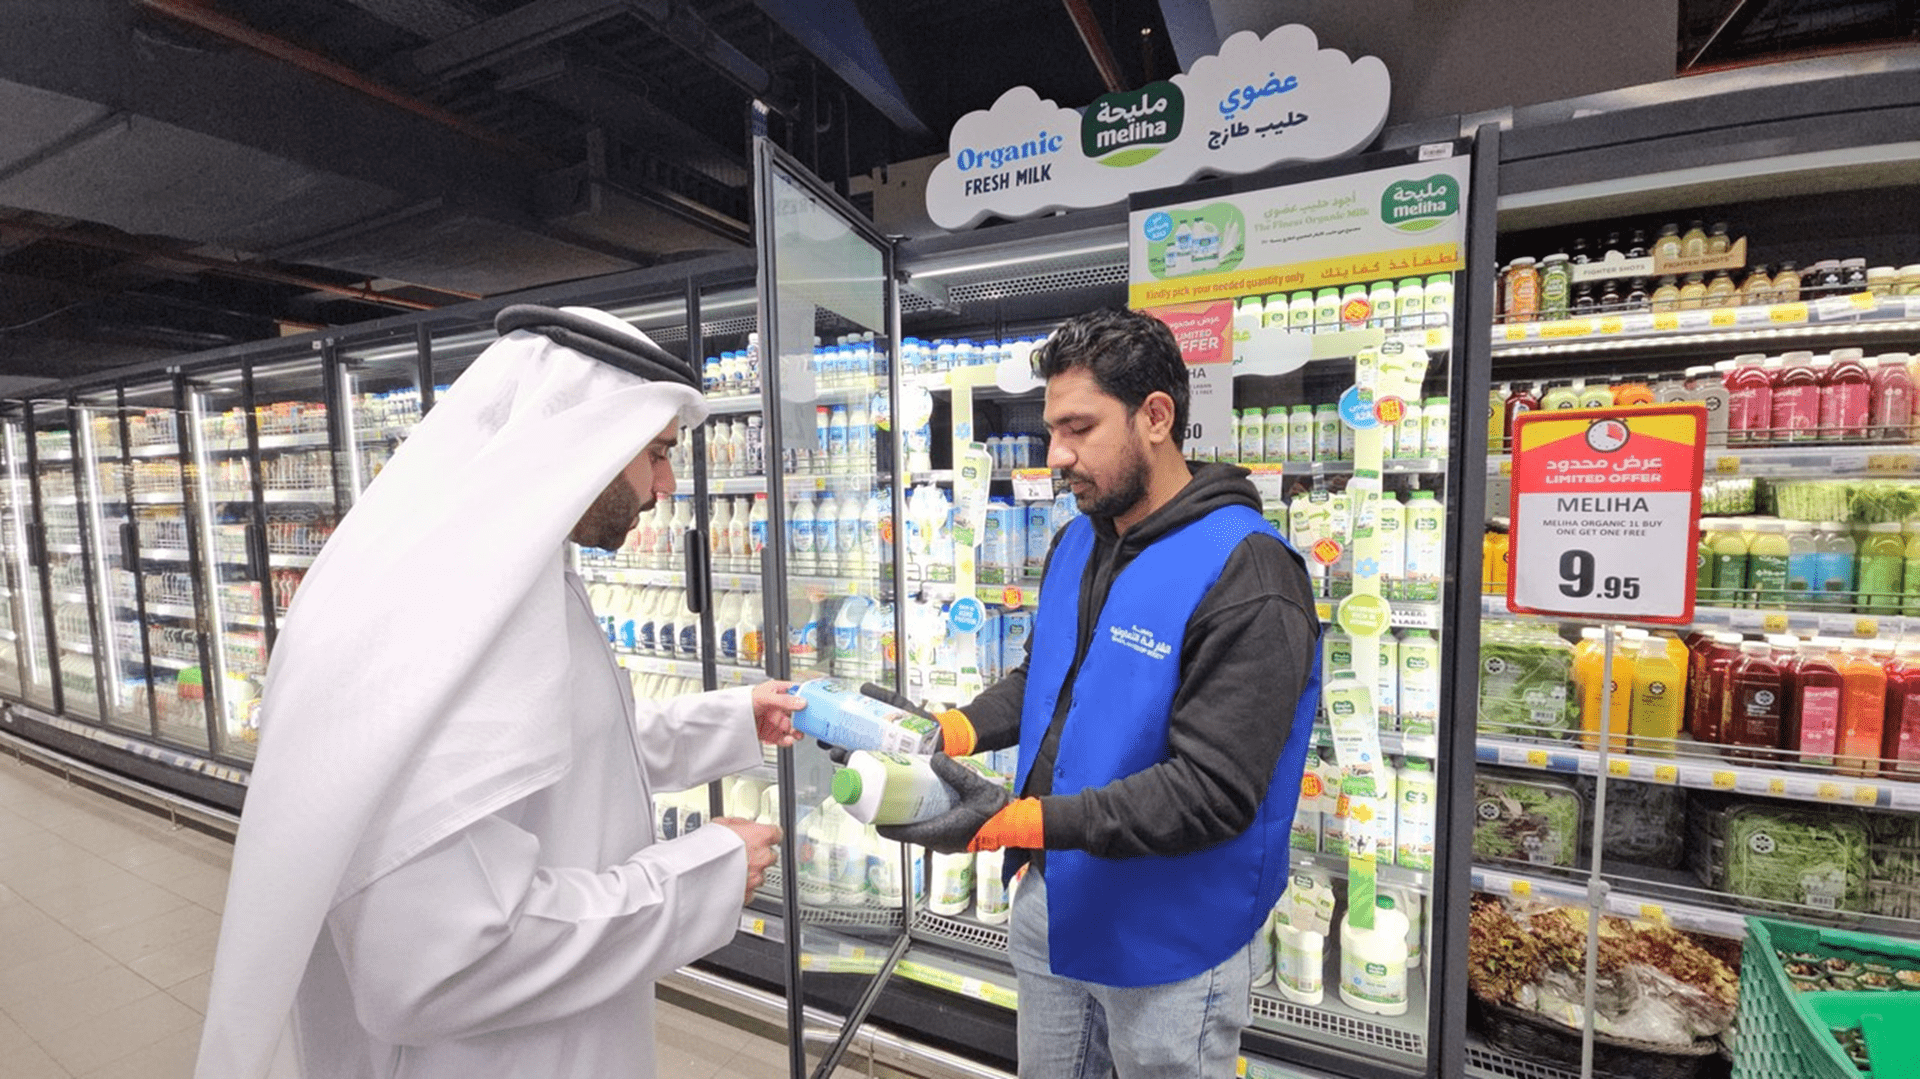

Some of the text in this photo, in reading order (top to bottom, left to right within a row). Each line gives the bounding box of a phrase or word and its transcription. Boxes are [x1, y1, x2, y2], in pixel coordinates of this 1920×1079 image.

[1219, 71, 1298, 120] عضوي
[1096, 94, 1168, 123] مليحة
[1096, 120, 1167, 149] meliha
[1208, 111, 1308, 150] حليب طازج
[956, 131, 1064, 172] Organic
[965, 163, 1052, 197] FRESH MILK
[1392, 182, 1448, 202] مليحة
[1254, 222, 1271, 232] The
[1305, 212, 1345, 225] Organic
[1347, 207, 1370, 217] Milk
[1393, 201, 1447, 218] meliha
[1583, 264, 1646, 276] FIGHTER SHOTS
[1146, 272, 1305, 300] Kindly pick your needed quantity only
[1175, 328, 1212, 342] LIMITED
[1180, 336, 1219, 353] FFER
[1546, 456, 1663, 472] عرض محدود
[1545, 473, 1662, 484] LIMITED OFFER
[1557, 497, 1649, 513] MELIHA
[1543, 519, 1663, 528] MELIHA ORGANIC 1L BUY
[1556, 528, 1647, 537] ONE GET ONE FREE
[1558, 549, 1641, 600] 9.95
